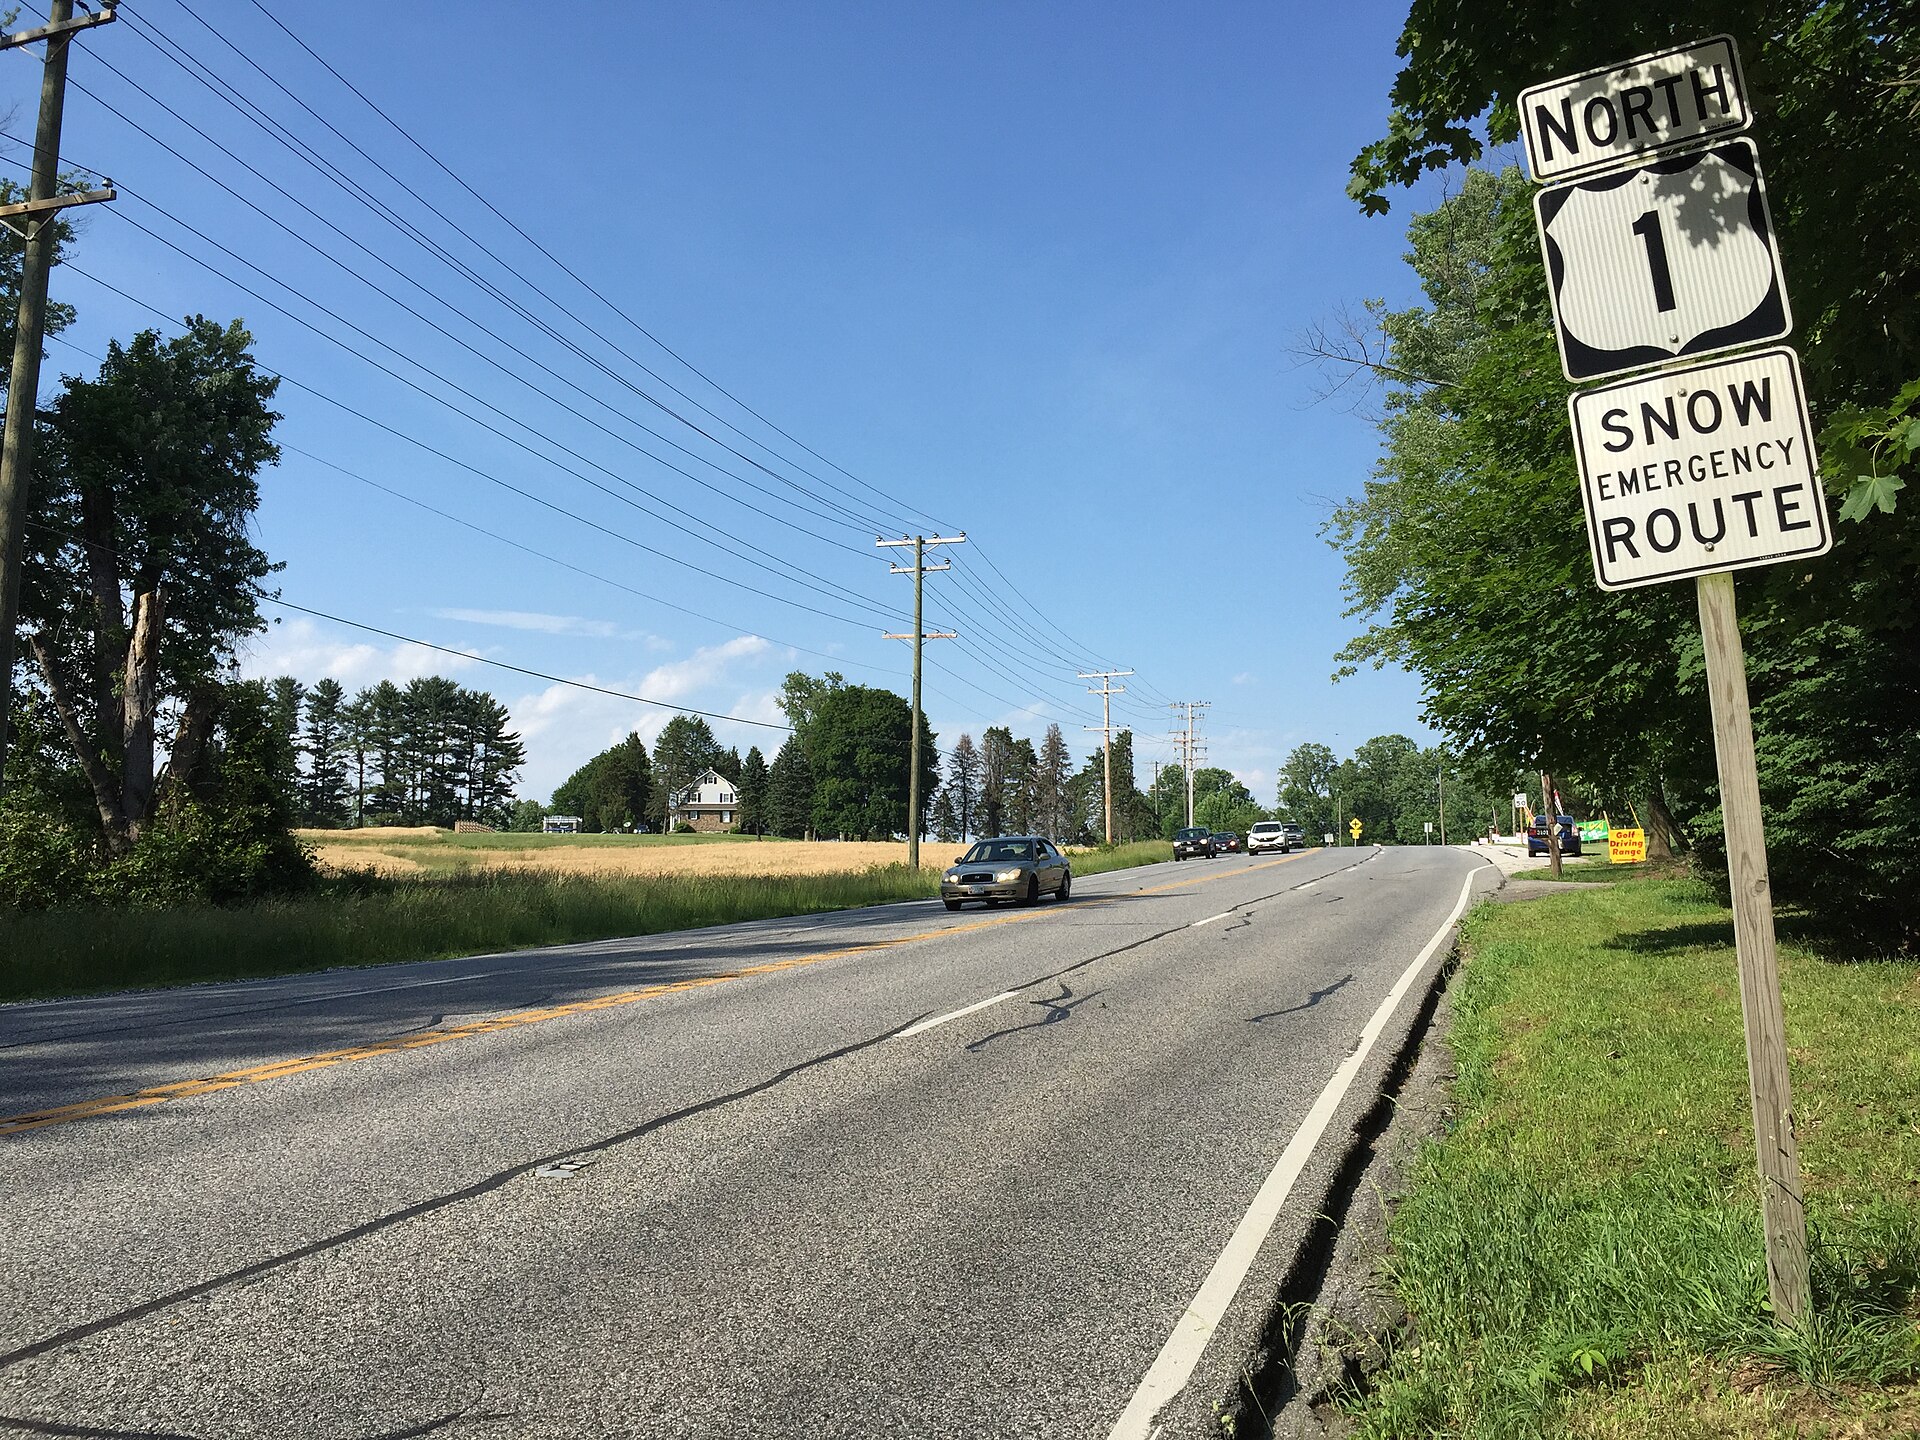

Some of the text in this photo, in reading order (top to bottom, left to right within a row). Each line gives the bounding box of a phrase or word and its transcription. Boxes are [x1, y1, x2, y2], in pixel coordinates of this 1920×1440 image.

[1535, 63, 1732, 162] NORTH
[1632, 209, 1676, 314] 1
[1601, 377, 1774, 453] SNOW
[1597, 437, 1795, 501] EMERGENCY
[1602, 483, 1811, 563] ROUTE
[1610, 840, 1643, 848] Driving
[1616, 831, 1635, 839] Golf
